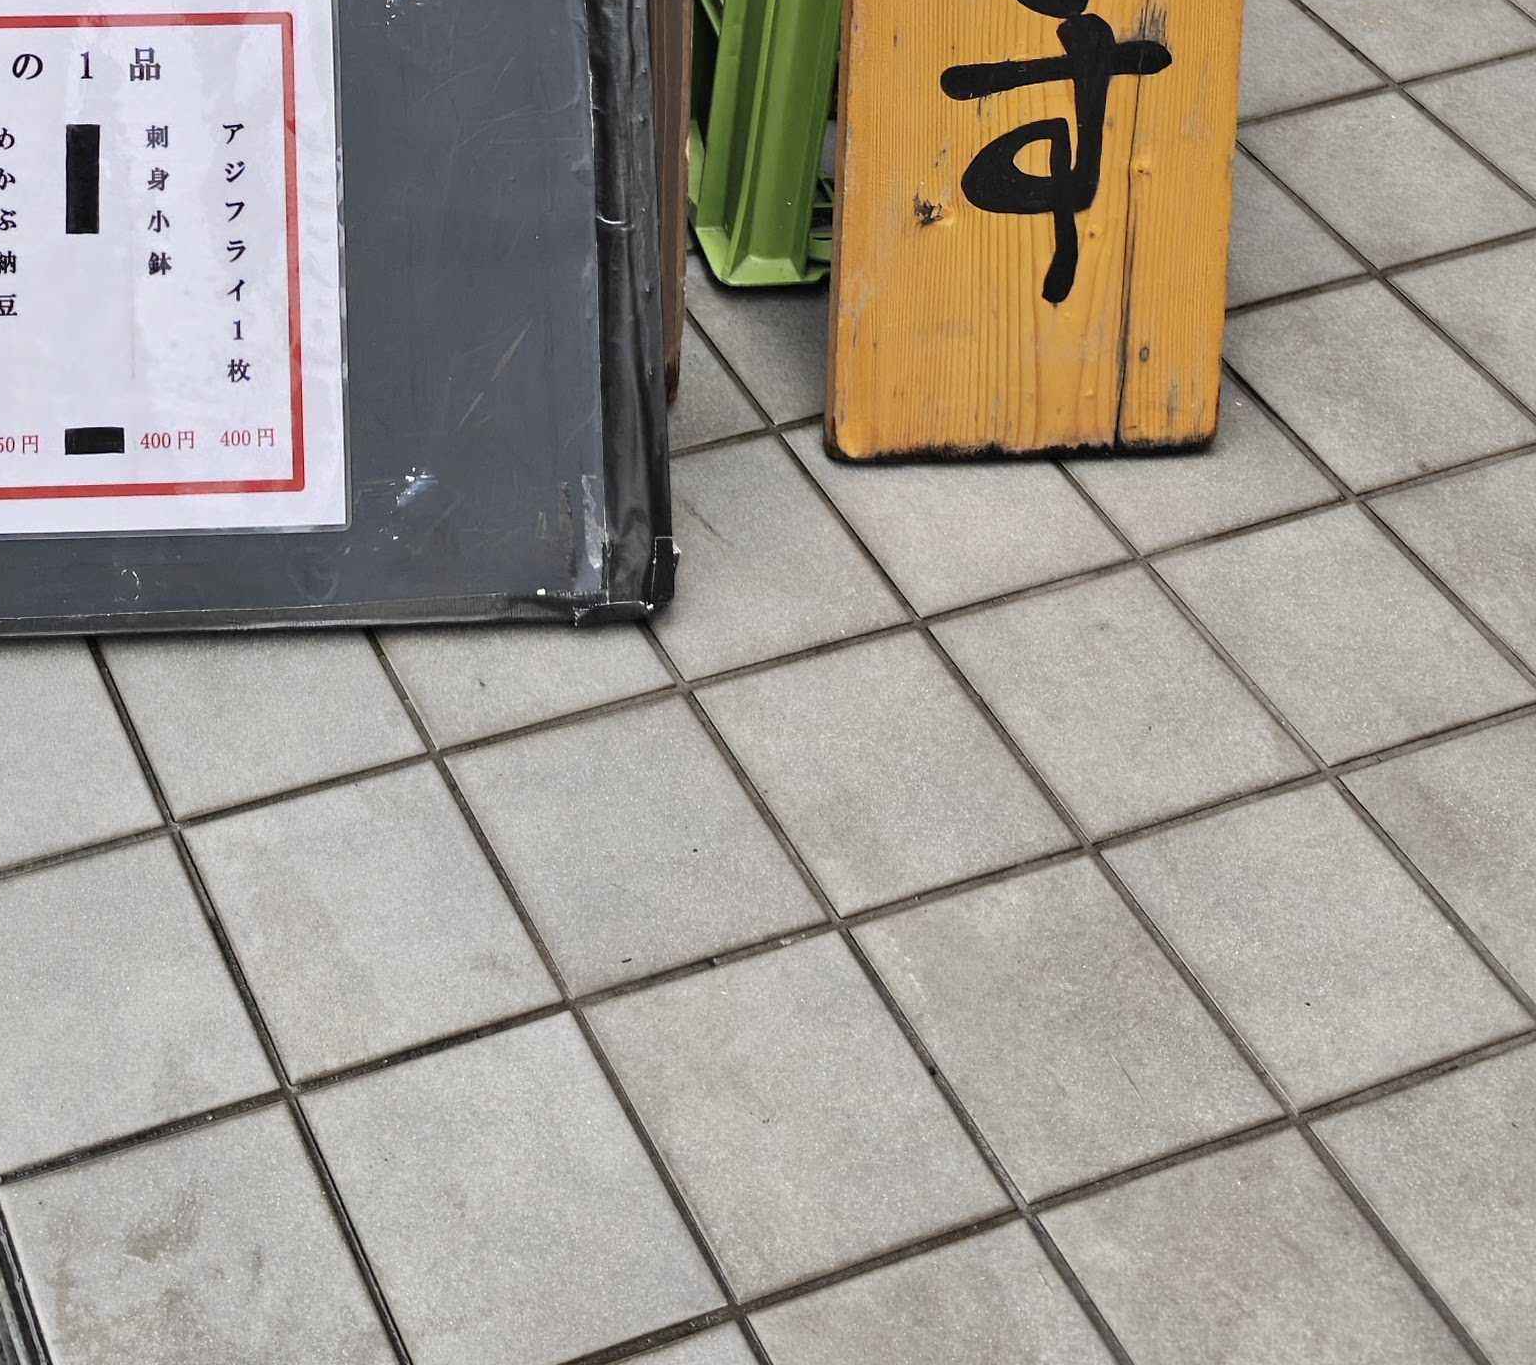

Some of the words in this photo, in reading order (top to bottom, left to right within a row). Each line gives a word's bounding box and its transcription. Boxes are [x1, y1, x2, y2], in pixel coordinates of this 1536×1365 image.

[145, 125, 172, 276] 刺身小鉢
[220, 120, 252, 385] アジフライ1枚
